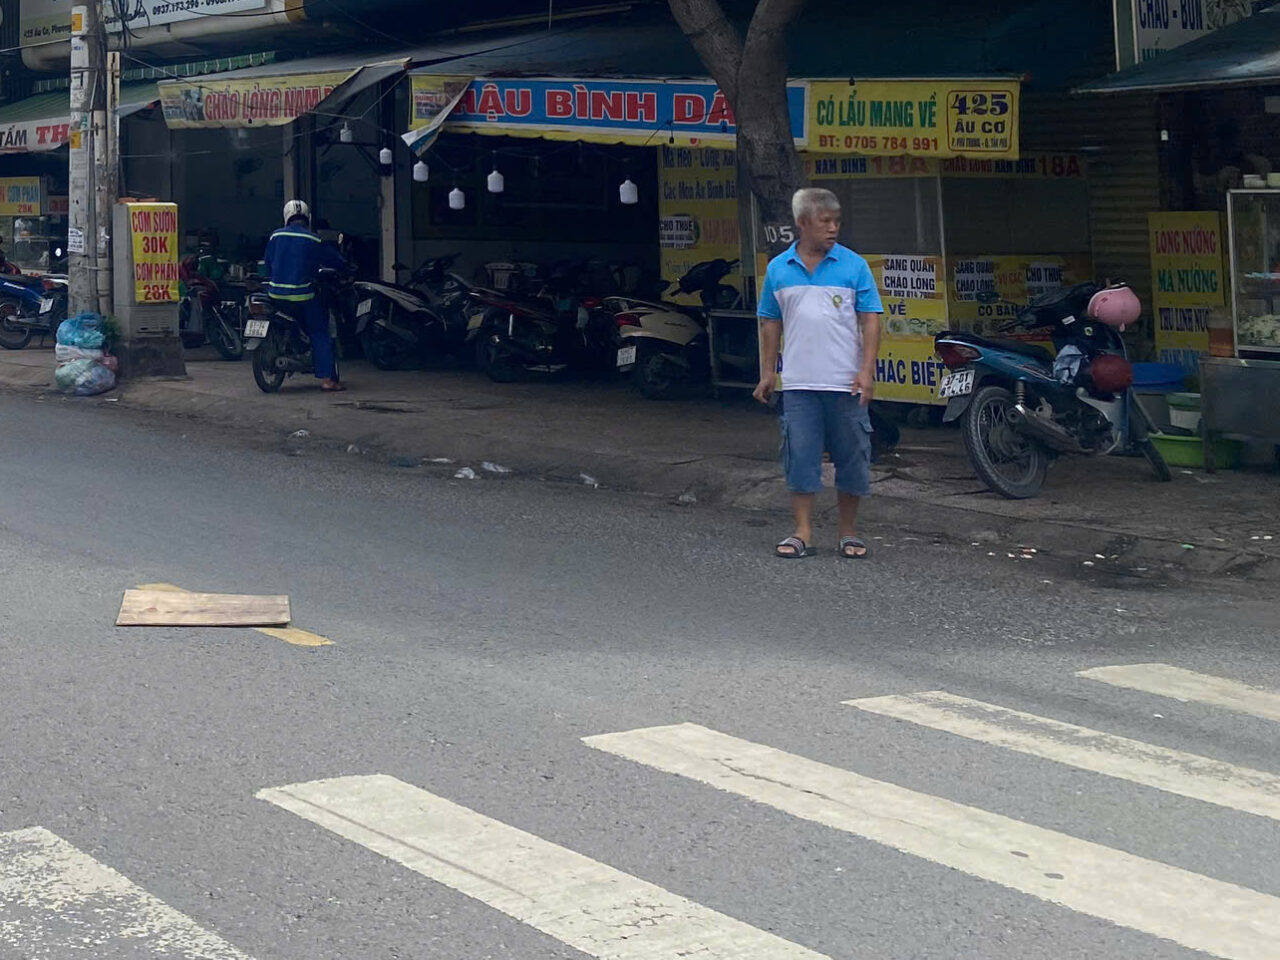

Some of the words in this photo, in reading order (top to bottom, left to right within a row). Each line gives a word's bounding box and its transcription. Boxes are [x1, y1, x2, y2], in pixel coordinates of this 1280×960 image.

[205, 85, 238, 121] CHÁO
[452, 83, 531, 122] HẬU
[546, 83, 658, 123] BÌNH
[673, 88, 737, 127] DÂ
[817, 95, 835, 127] CÓ
[839, 90, 866, 127] LẨU
[870, 100, 914, 128] MANG
[918, 92, 937, 128] VỀ
[951, 93, 1009, 116] 425
[36, 123, 70, 145] TH
[955, 118, 975, 133] ÂU
[981, 118, 1006, 134] CƠ
[819, 134, 841, 148] ĐT:
[844, 135, 877, 149] 0705
[882, 136, 907, 150] 784
[912, 137, 938, 151] 991
[815, 159, 838, 173] NAM
[1039, 154, 1081, 177] 18A
[725, 179, 737, 200] Dâ
[131, 209, 151, 233] CƠM
[142, 236, 168, 253] 30K
[884, 258, 908, 271] SANG
[884, 273, 908, 289] CHÁO
[1025, 267, 1042, 282] CHO
[143, 284, 172, 301] 28K
[888, 298, 907, 316] VỀ
[873, 352, 906, 385] HÁC
[911, 356, 947, 394] BIỆT
